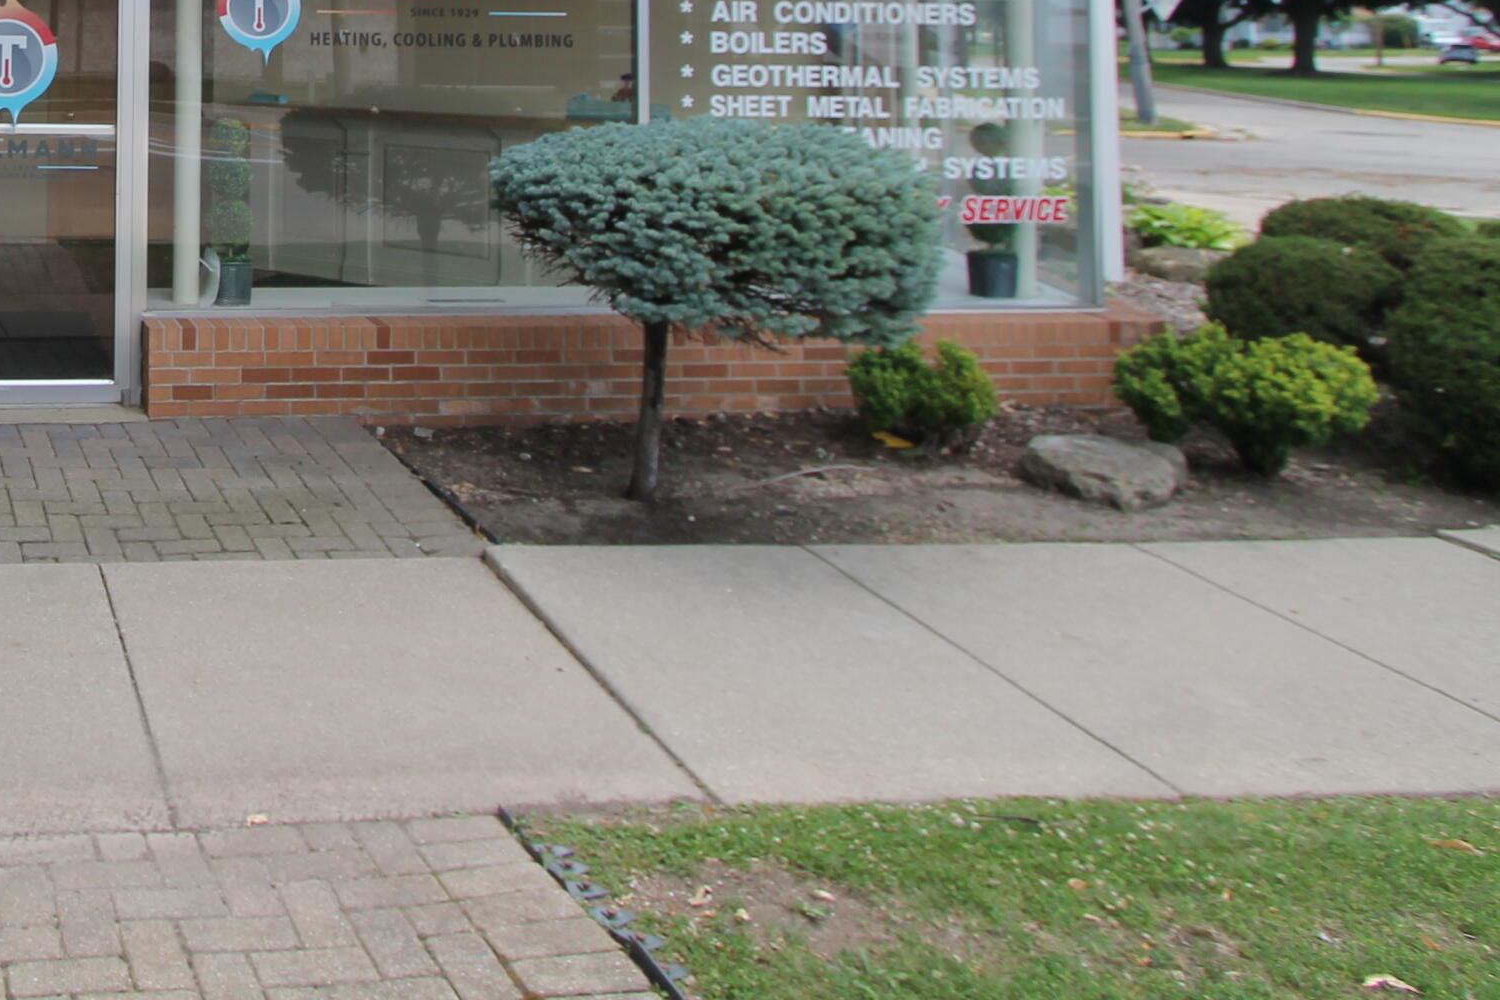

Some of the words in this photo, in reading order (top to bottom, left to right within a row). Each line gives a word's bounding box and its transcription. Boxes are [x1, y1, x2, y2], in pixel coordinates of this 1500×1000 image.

[410, 7, 444, 17] SINCE
[711, 0, 758, 23] AIR
[773, 1, 976, 26] CONDITIONERS
[310, 32, 387, 49] HEATING,
[393, 32, 466, 48] COOLING
[472, 33, 483, 48] &
[488, 33, 574, 49] PLUMBING
[710, 31, 828, 55] BOILERS
[711, 64, 900, 88] GEOTHERMAL
[916, 66, 1040, 89] SYSTEMS
[710, 95, 793, 118] SHEET
[807, 96, 890, 119] METAL
[904, 97, 1065, 119] FABRICATION
[943, 156, 1067, 179] SYSTEMS
[961, 196, 1070, 223] SERVICE
